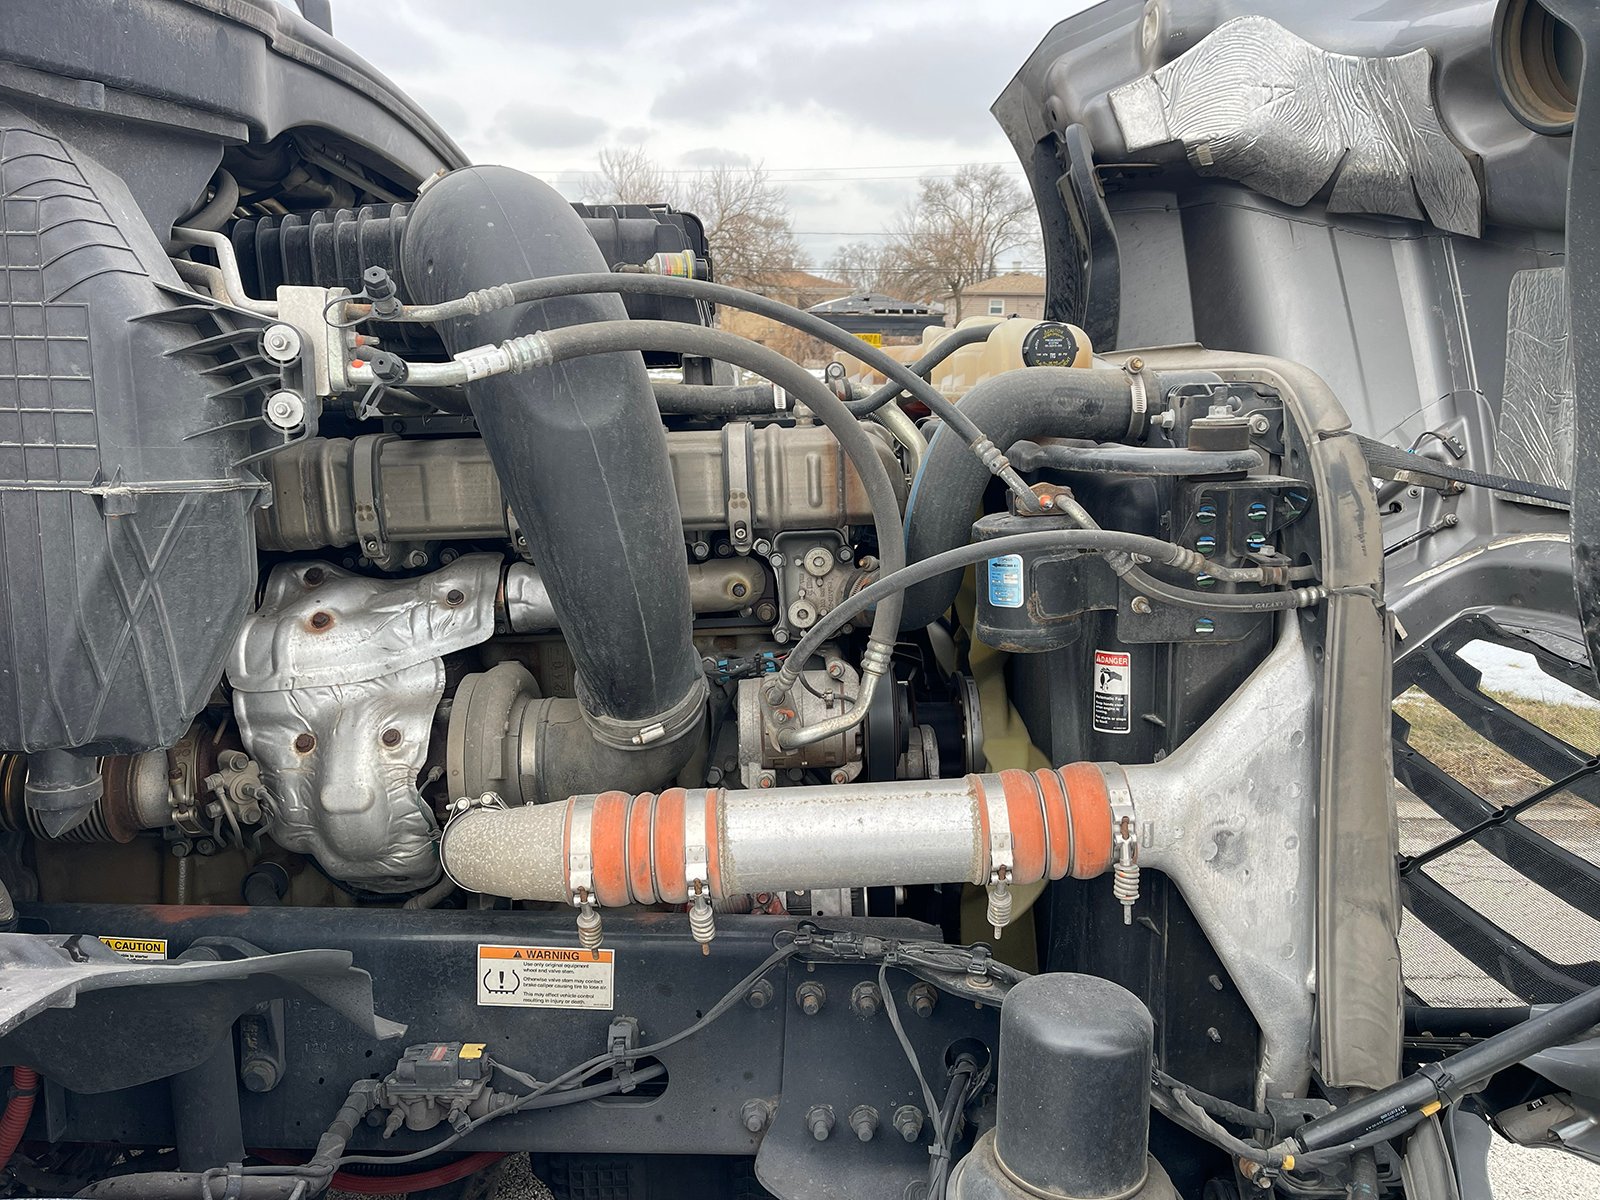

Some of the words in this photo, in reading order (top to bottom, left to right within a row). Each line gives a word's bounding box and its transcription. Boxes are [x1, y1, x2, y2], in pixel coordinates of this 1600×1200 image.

[1255, 601, 1284, 609] GALAXY
[1100, 656, 1128, 665] DANGER
[115, 941, 161, 951] CAUTION
[527, 950, 580, 960] WARNING
